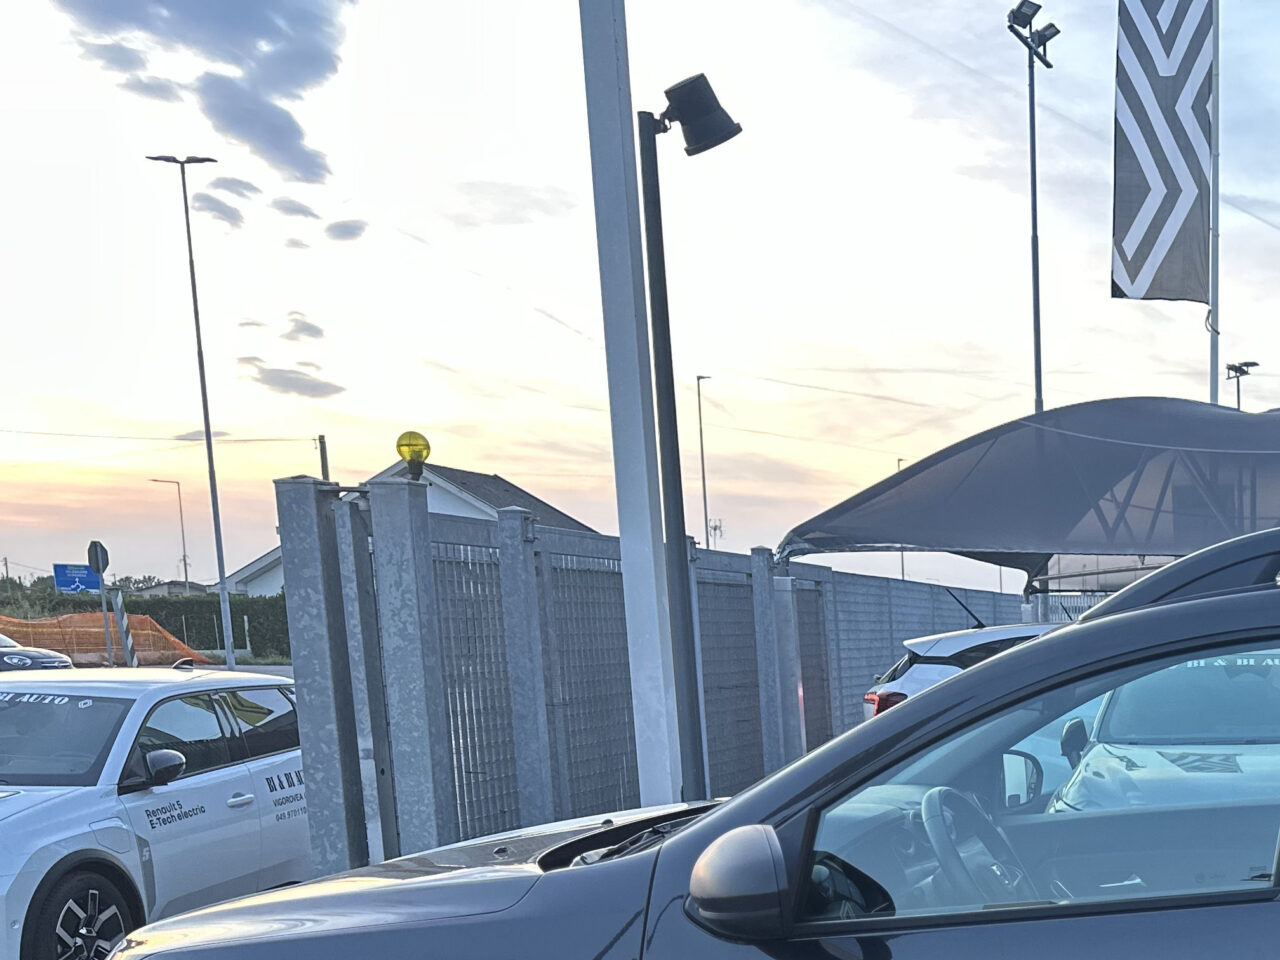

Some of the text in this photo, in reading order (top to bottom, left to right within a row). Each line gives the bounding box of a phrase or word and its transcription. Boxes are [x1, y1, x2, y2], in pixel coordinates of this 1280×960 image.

[1187, 660, 1205, 668] BI
[16, 694, 70, 705] AUTO
[272, 793, 304, 807] VIGOROVEA
[145, 800, 183, 819] Renault 5
[149, 804, 206, 830] E-Tech electric
